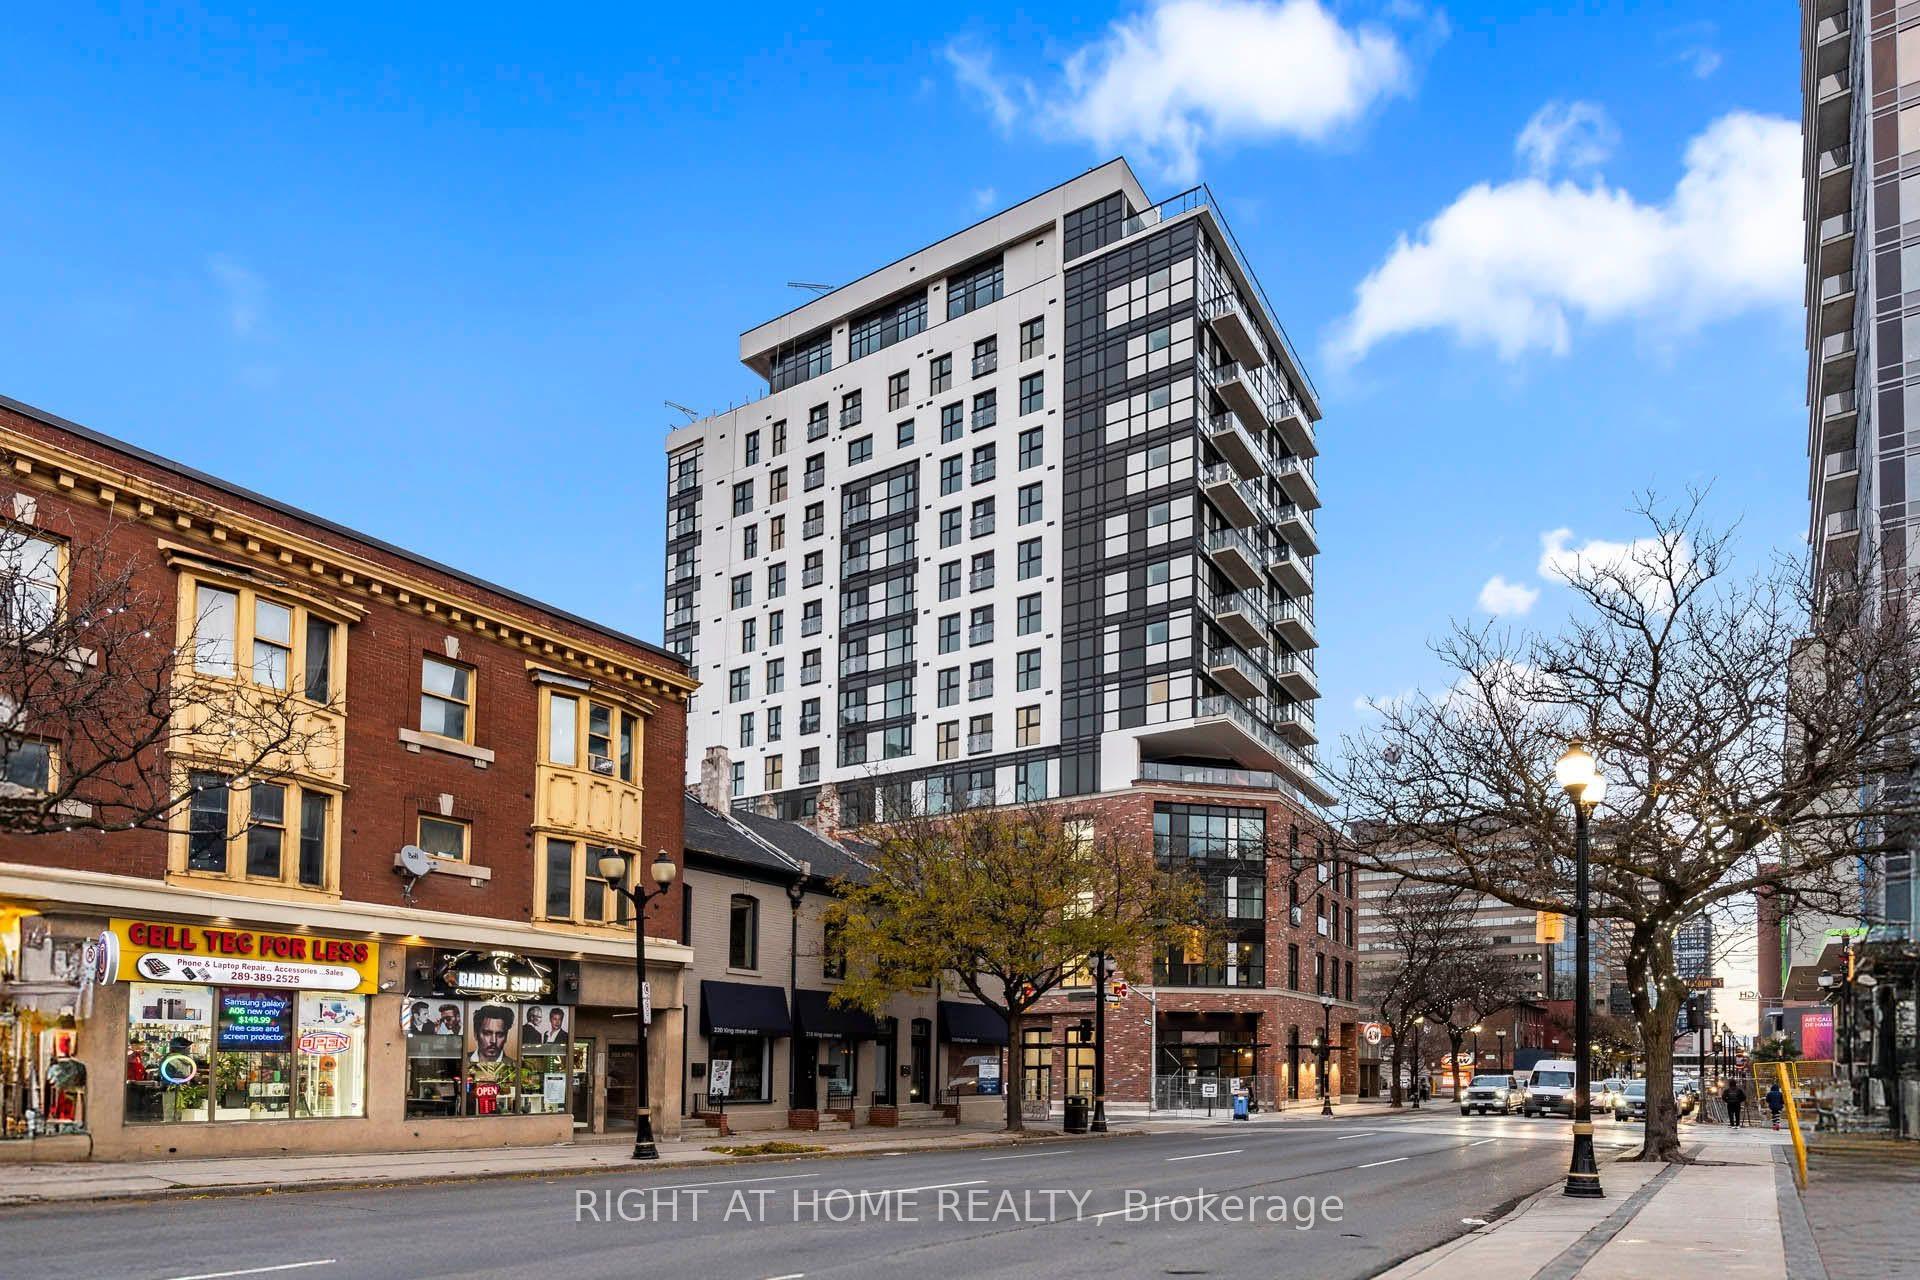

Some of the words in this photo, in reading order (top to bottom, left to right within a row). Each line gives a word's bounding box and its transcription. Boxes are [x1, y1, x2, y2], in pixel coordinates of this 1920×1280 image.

[128, 922, 197, 950] CELL
[203, 930, 253, 954] TEC
[260, 935, 306, 959] FOR
[313, 940, 368, 963] LESS
[177, 959, 202, 967] Phone
[213, 962, 240, 970] Laptop
[274, 965, 317, 974] Accessories
[231, 972, 300, 983] 289-389-2525
[459, 971, 507, 989] BARBER
[511, 976, 542, 992] SHOP
[224, 998, 260, 1007] Samsung
[262, 1000, 286, 1008] galaxy
[238, 1016, 271, 1024] $149.99
[251, 1034, 285, 1042] protector
[299, 1036, 351, 1050] OPEN
[477, 1086, 498, 1096] OPEN
